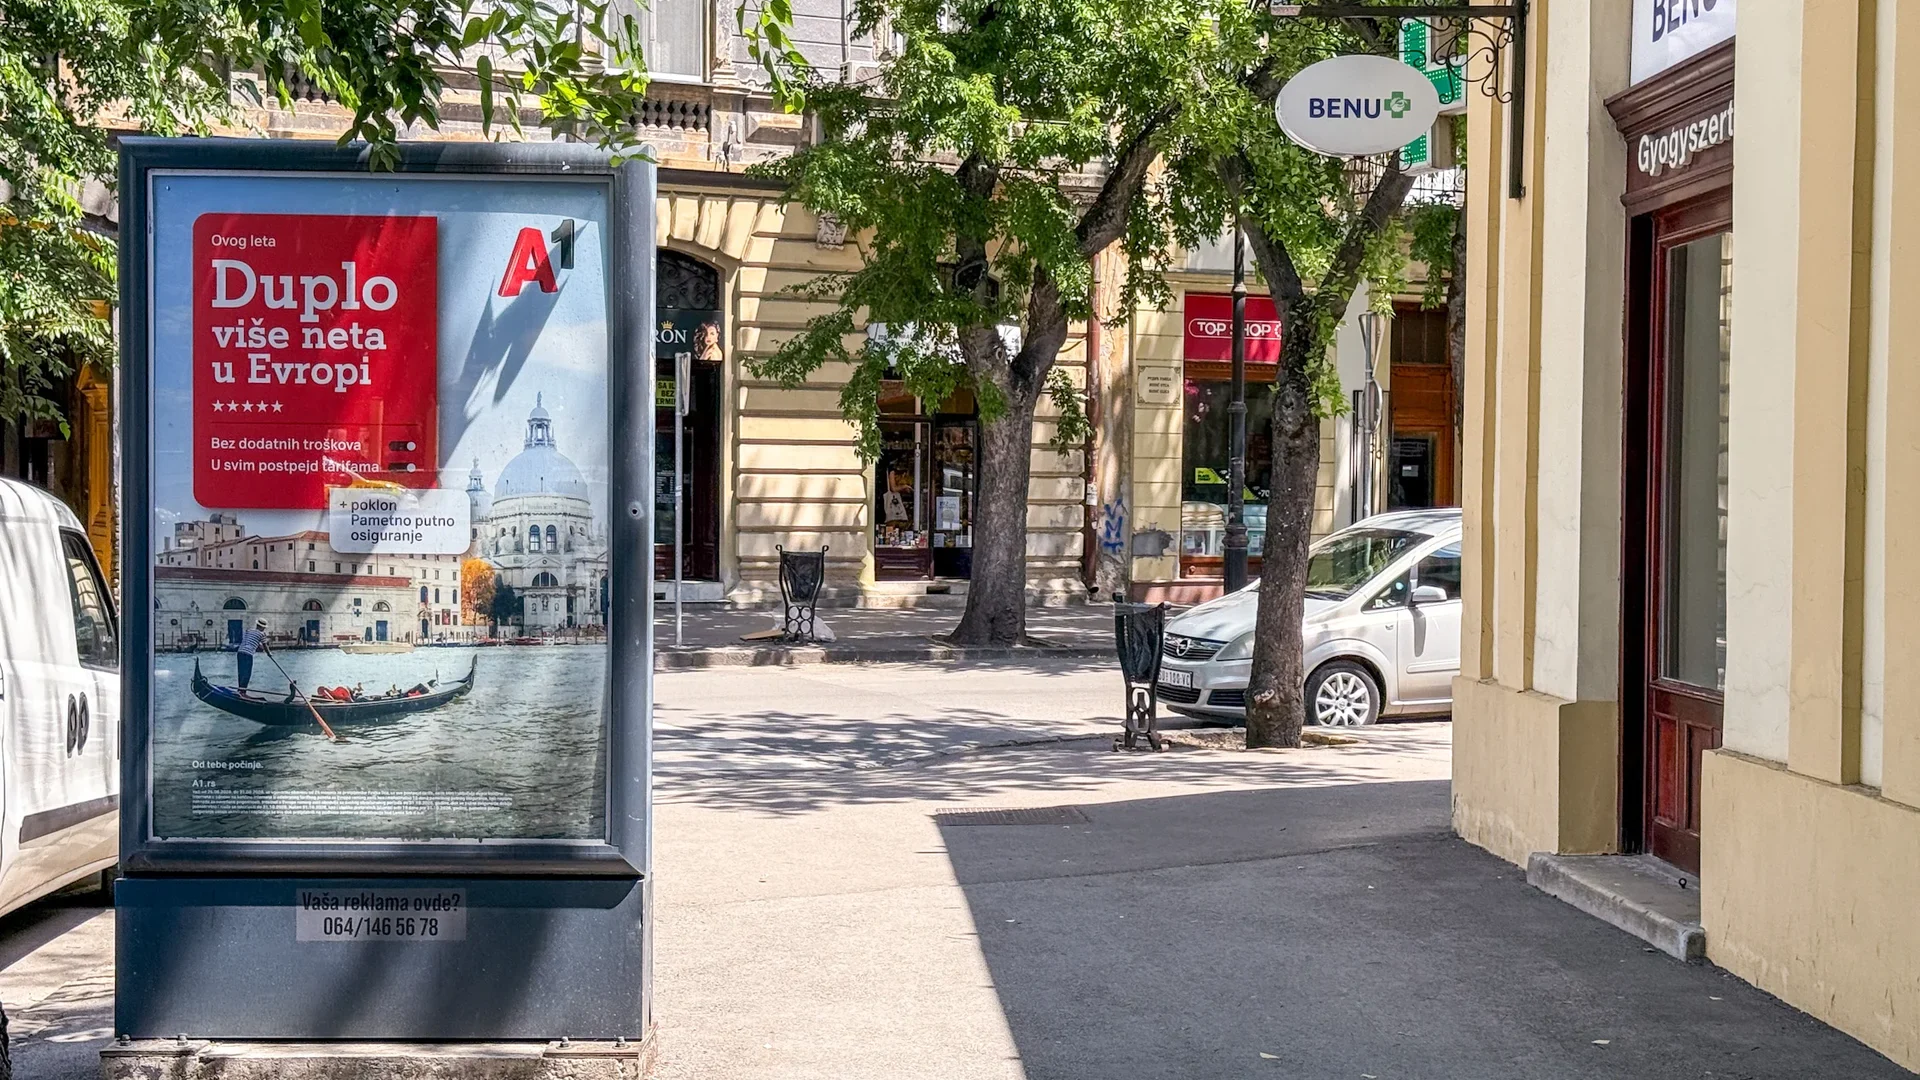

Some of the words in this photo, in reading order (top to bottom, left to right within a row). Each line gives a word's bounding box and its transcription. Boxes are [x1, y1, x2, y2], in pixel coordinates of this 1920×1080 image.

[1309, 97, 1381, 119] BENU
[211, 234, 247, 250] Ovog
[250, 234, 276, 248] leta
[498, 219, 575, 297] A1
[211, 259, 399, 323] Duplo
[212, 318, 289, 349] više
[302, 322, 387, 350] neta
[1197, 322, 1227, 336] TOP
[212, 361, 236, 384] u
[248, 353, 372, 392] Evropi
[211, 437, 236, 450] Bez
[239, 437, 300, 451] dodatnih
[303, 437, 362, 452] troškova
[211, 459, 221, 471] U
[224, 459, 255, 472] svim
[258, 459, 319, 475] postpejd
[322, 460, 380, 473] tarifama
[351, 499, 397, 513] poklon
[351, 514, 412, 526] Pametno
[415, 515, 455, 529] putno
[351, 529, 423, 544] osiguranje
[192, 760, 205, 770] Od
[207, 760, 227, 770] tebe
[228, 759, 264, 772] počinje.
[192, 779, 216, 788] A1.rs
[302, 891, 341, 912] Vaša
[344, 891, 410, 912] reklama
[413, 892, 461, 912] ovde?
[323, 917, 391, 938] 064/146
[395, 917, 415, 937] 56
[419, 918, 439, 937] 78
